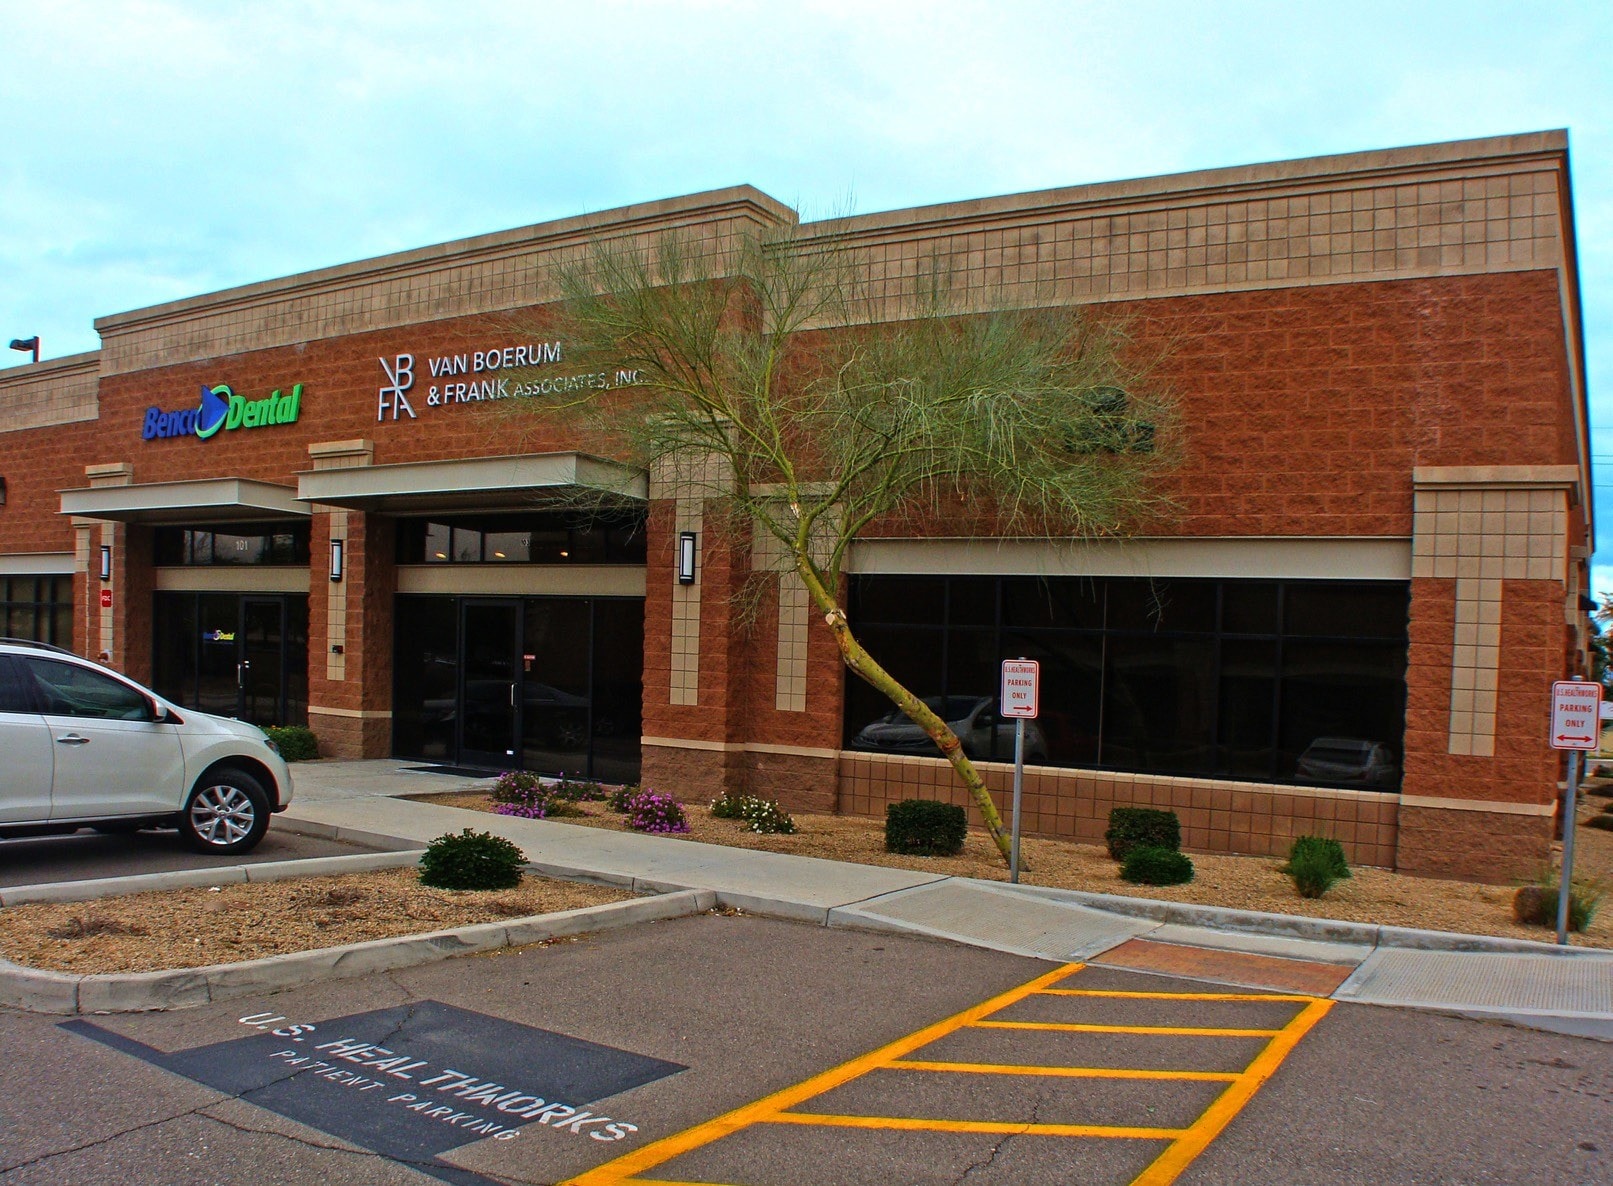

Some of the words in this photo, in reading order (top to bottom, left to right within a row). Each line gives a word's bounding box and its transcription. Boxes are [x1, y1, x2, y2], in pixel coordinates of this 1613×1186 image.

[428, 353, 469, 378] VAN
[473, 341, 563, 373] BOERUM
[427, 385, 442, 406] &
[444, 378, 512, 404] FRANK
[225, 383, 304, 430] Dental
[1007, 679, 1032, 687] PARKING
[1560, 703, 1593, 713] PARKING
[1565, 719, 1585, 728] ONLY
[269, 1049, 386, 1092] PATIENT
[388, 1093, 521, 1141] PARKING
